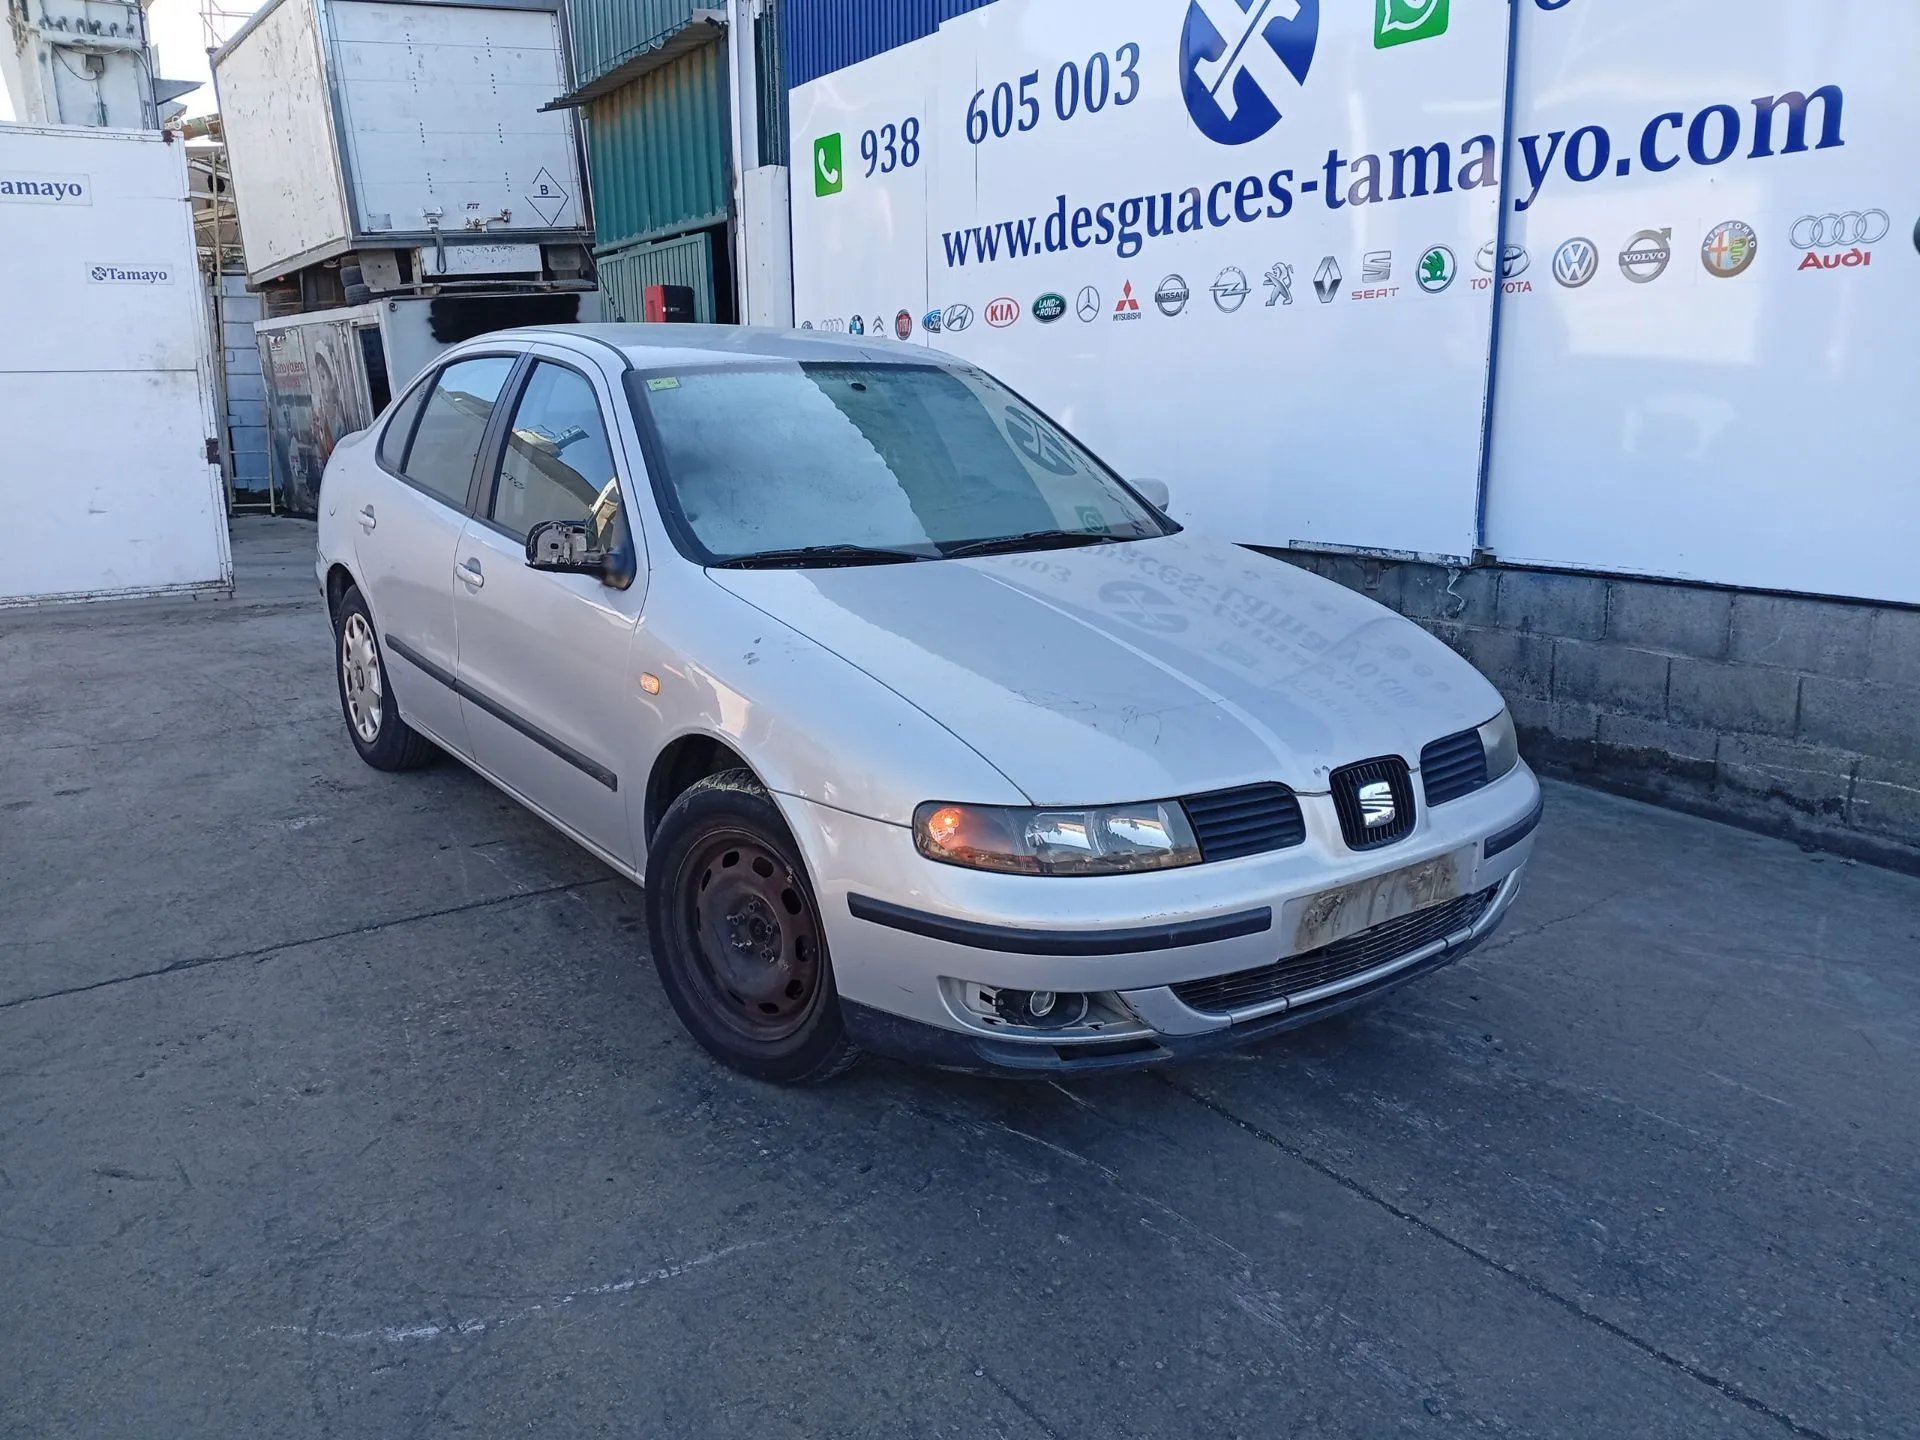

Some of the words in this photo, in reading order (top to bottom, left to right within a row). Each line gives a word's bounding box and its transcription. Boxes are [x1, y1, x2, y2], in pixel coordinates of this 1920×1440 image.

[859, 117, 921, 179] 938
[966, 70, 1040, 145] 605
[1054, 42, 1141, 121] 003
[941, 84, 1846, 268] www.desguaces-tamayo.com
[0, 180, 82, 200] amayo
[540, 184, 549, 195] B
[1623, 251, 1667, 263] VOLVO
[1797, 248, 1871, 271] Audi
[107, 268, 168, 284] Tamayo
[1157, 291, 1186, 300] NISSAN
[1351, 287, 1400, 300] SEAT
[1038, 299, 1056, 309] LAND
[990, 303, 1014, 322] KIA
[1039, 306, 1061, 317] ROVER
